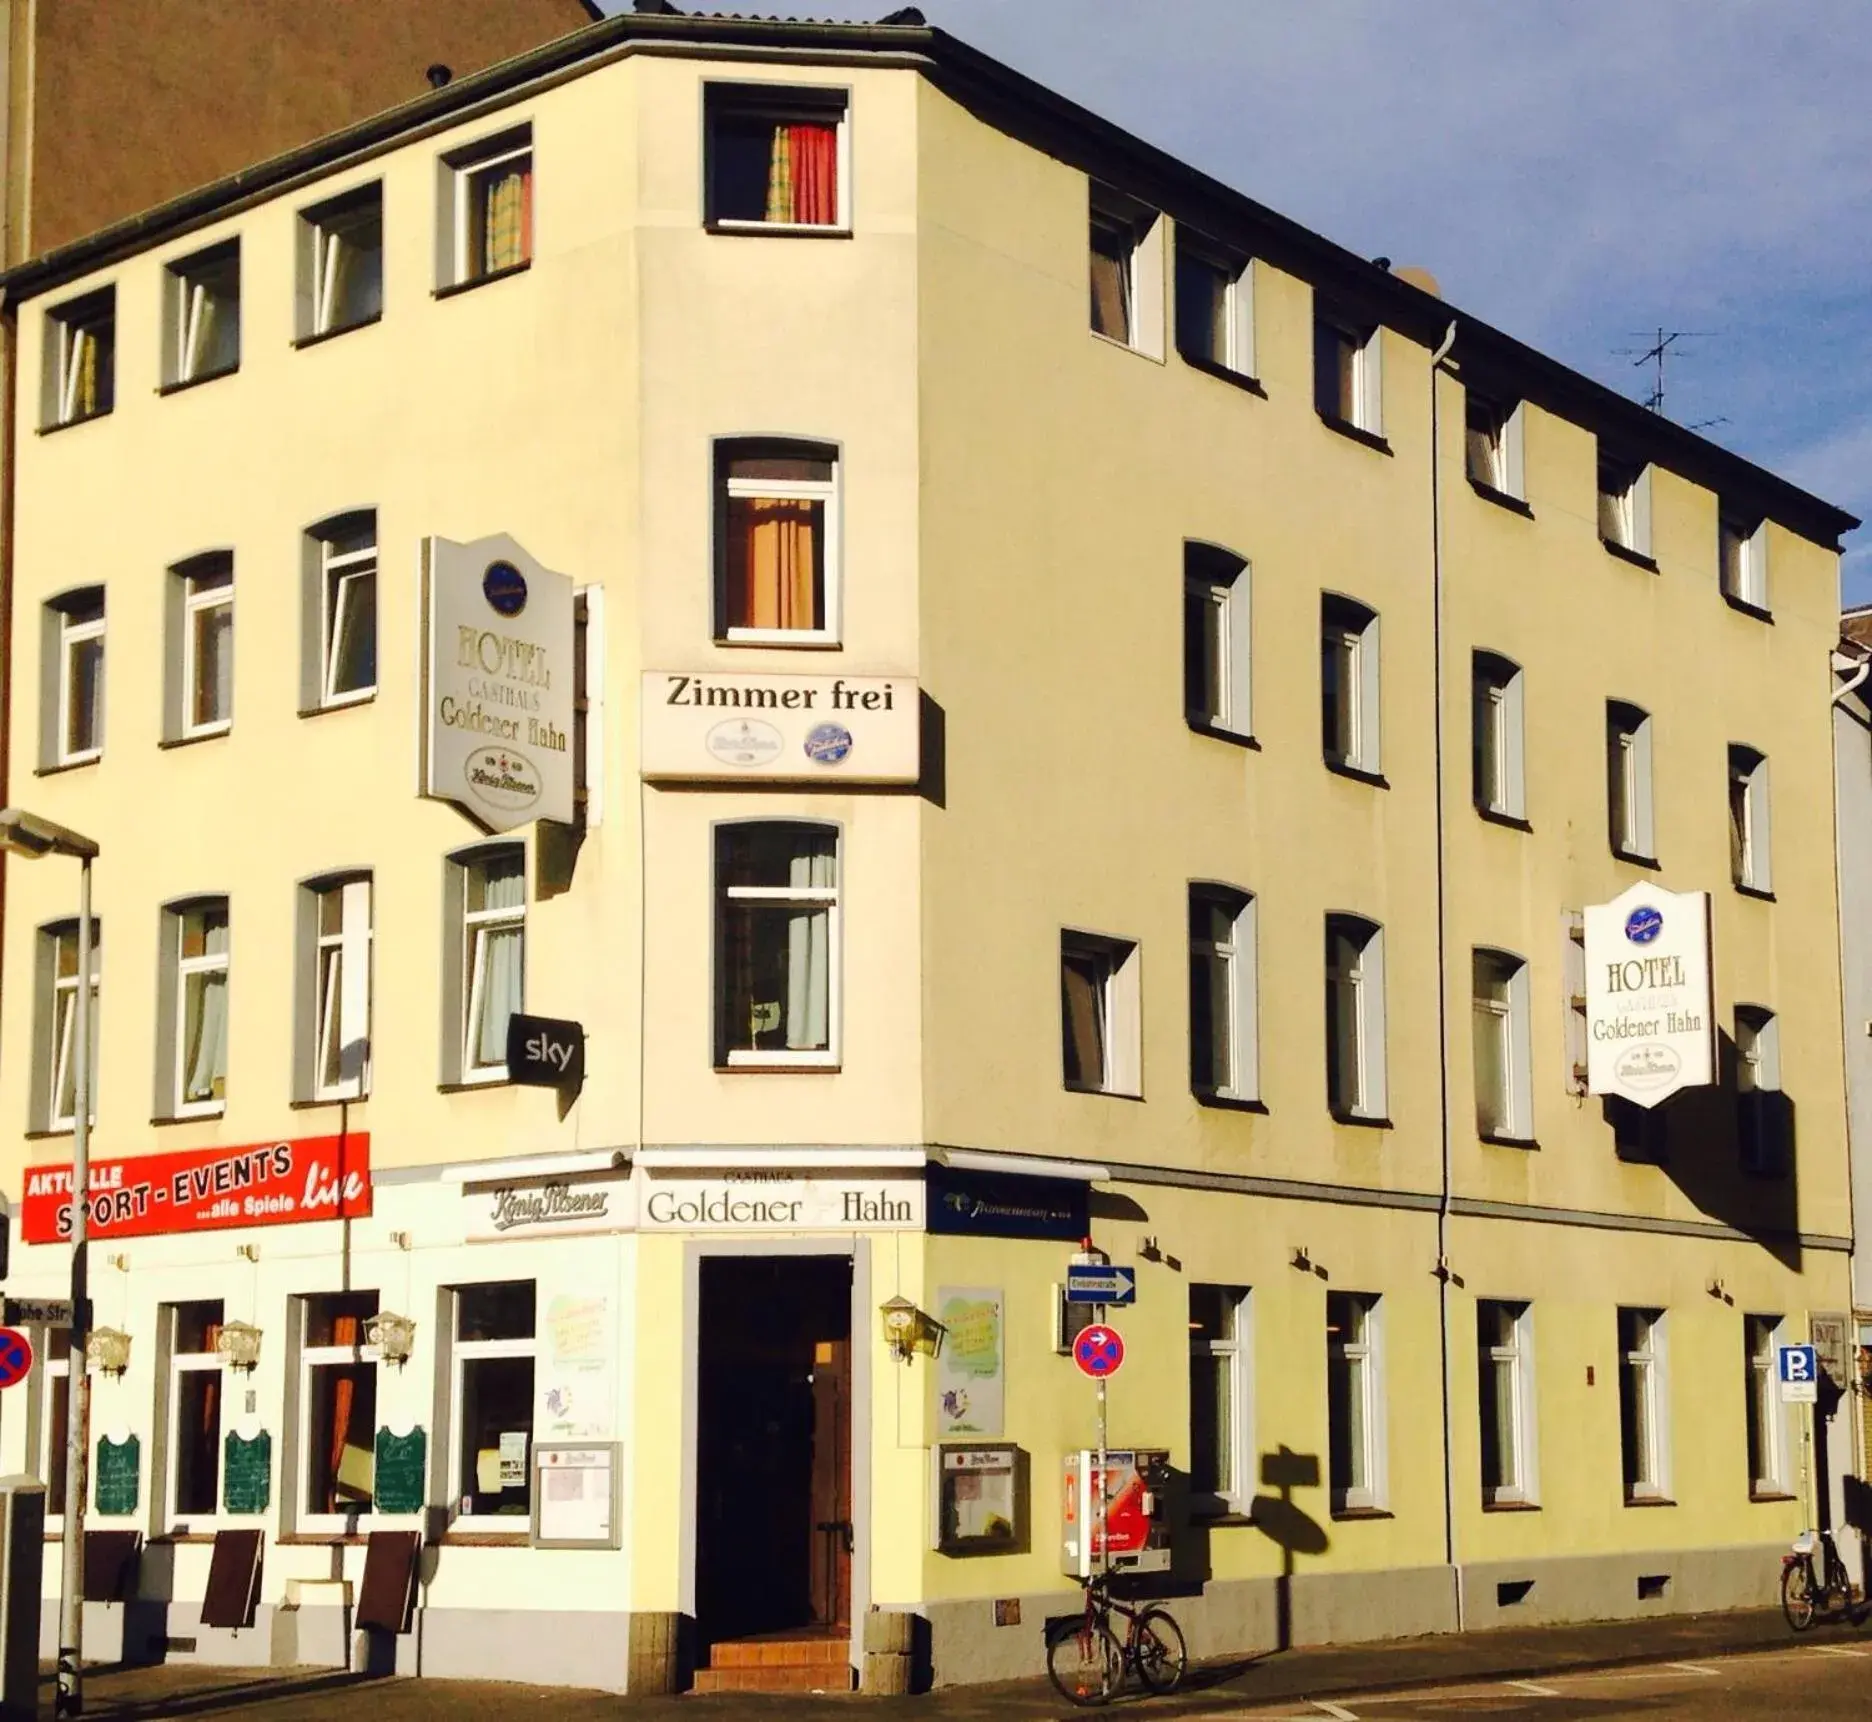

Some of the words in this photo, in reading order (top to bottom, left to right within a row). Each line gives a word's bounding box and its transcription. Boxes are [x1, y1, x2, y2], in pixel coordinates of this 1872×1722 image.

[457, 624, 551, 691] HOTEL
[666, 675, 818, 710] Zimmer
[831, 679, 894, 711] frei
[440, 696, 520, 742] Goldener
[528, 716, 567, 753] Hahn
[1607, 955, 1686, 994] HOTEL
[1593, 1017, 1661, 1041] Goldener
[1666, 1009, 1701, 1034] Hahn
[525, 1031, 575, 1072] sky
[243, 1194, 295, 1218] Spiele
[299, 1160, 365, 1210] live
[490, 1186, 544, 1223] König
[541, 1181, 609, 1217] Pilsener
[647, 1189, 803, 1224] Goldener
[840, 1188, 913, 1223] Hahn
[1786, 1349, 1808, 1381] P
